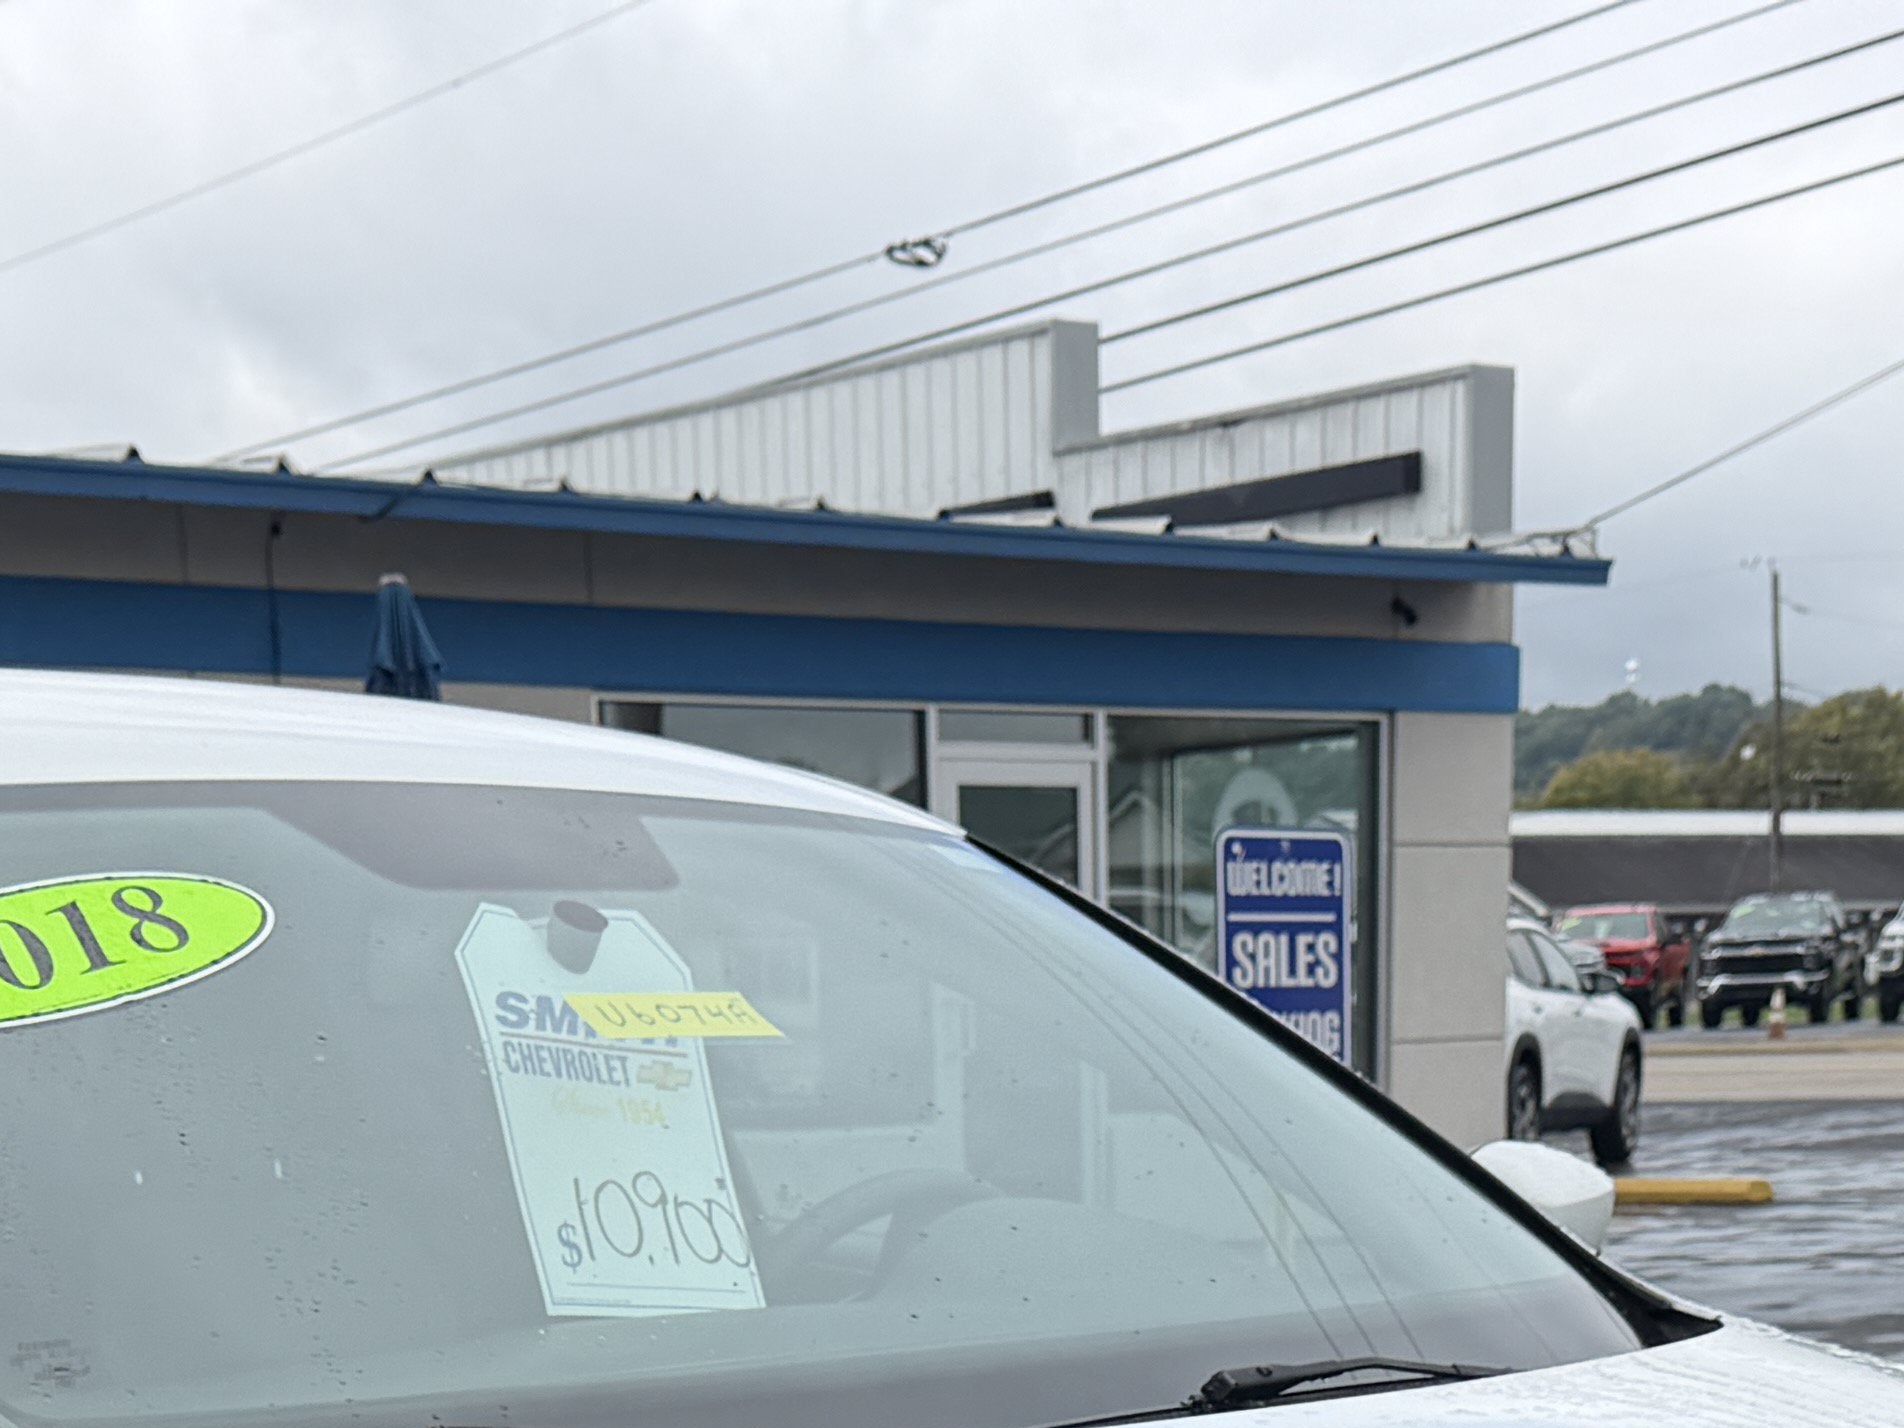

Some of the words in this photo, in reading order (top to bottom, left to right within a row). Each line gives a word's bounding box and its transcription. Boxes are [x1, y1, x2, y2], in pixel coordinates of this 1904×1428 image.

[1227, 859, 1341, 897] WELCOME!
[1232, 931, 1339, 988] SALES
[501, 1039, 631, 1088] CHEVROLET
